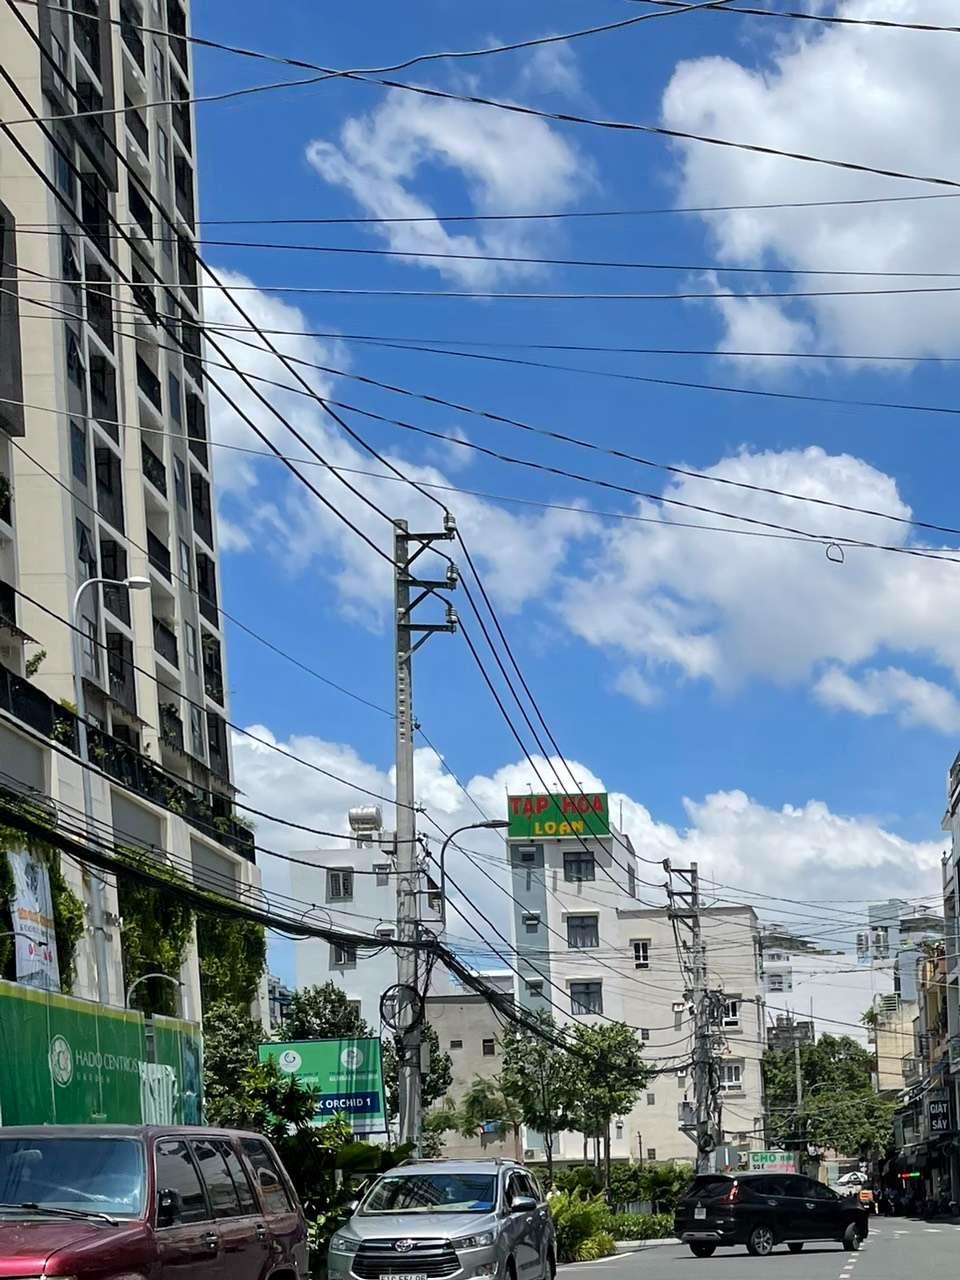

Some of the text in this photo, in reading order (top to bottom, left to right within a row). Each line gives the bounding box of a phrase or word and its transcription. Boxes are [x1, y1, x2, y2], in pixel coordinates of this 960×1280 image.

[534, 819, 585, 834] LOAN
[103, 1054, 139, 1073] CENTROS
[325, 1098, 364, 1109] ORCHID
[366, 1098, 371, 1106] 1
